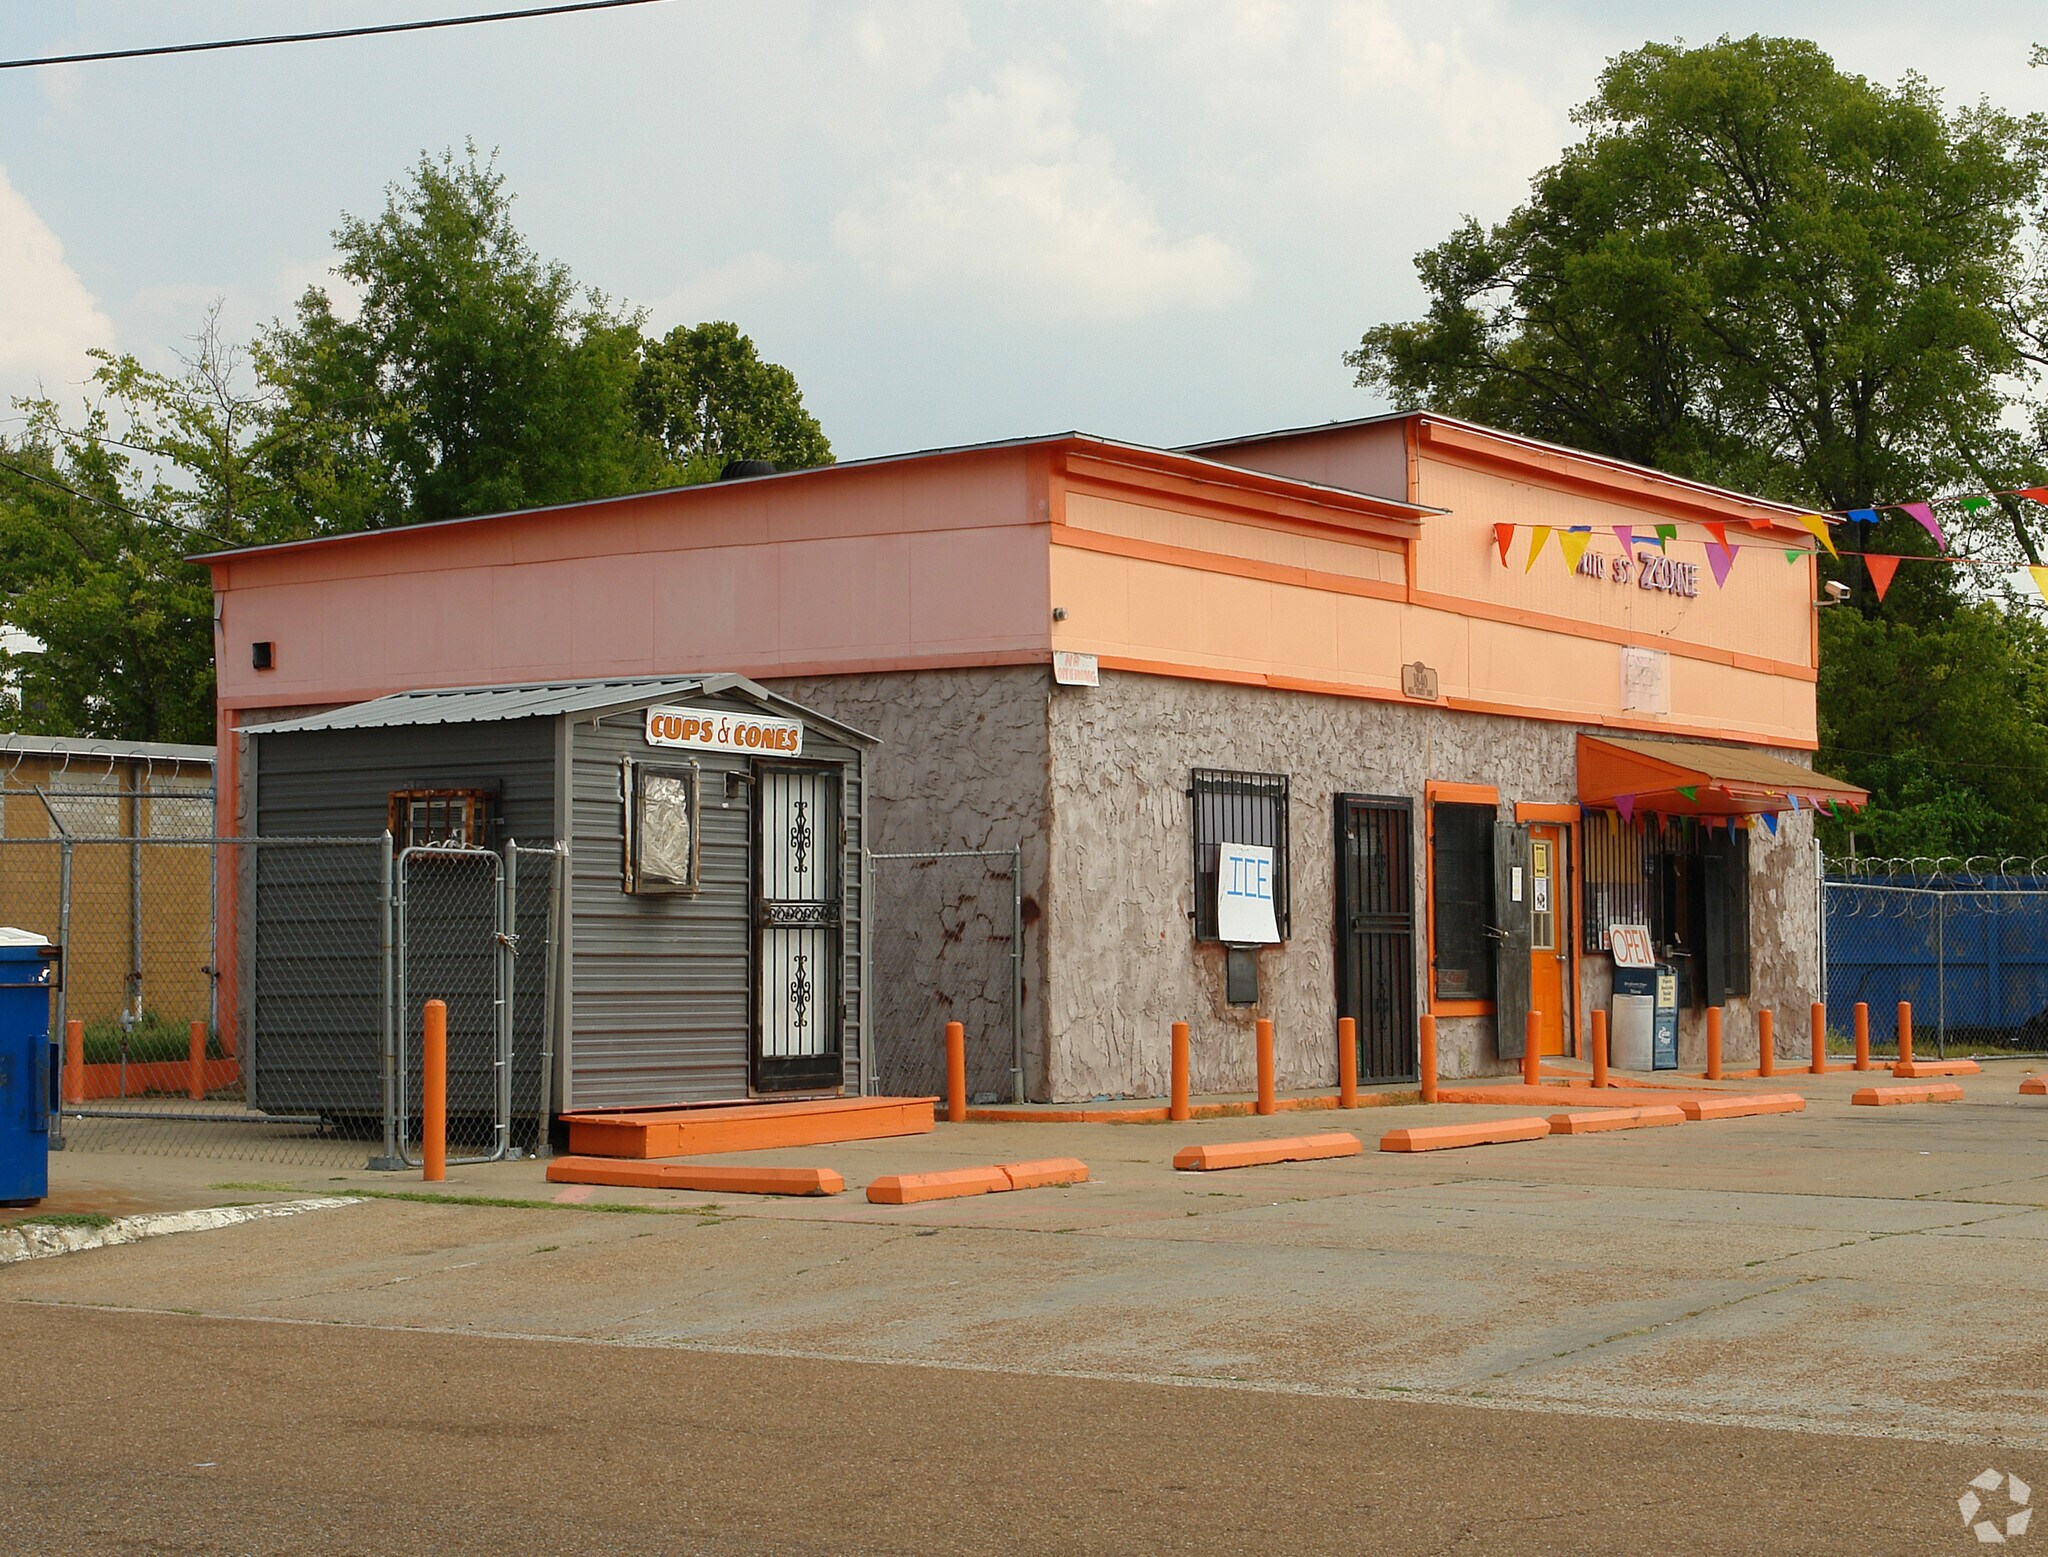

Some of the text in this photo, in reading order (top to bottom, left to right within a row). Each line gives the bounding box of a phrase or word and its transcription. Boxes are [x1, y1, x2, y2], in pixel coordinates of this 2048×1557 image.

[1638, 552, 1701, 598] ZONE
[1064, 653, 1081, 668] NO
[651, 712, 798, 752] CUPS & CONES
[1227, 856, 1271, 900] ICE
[1612, 929, 1652, 964] OPEN
